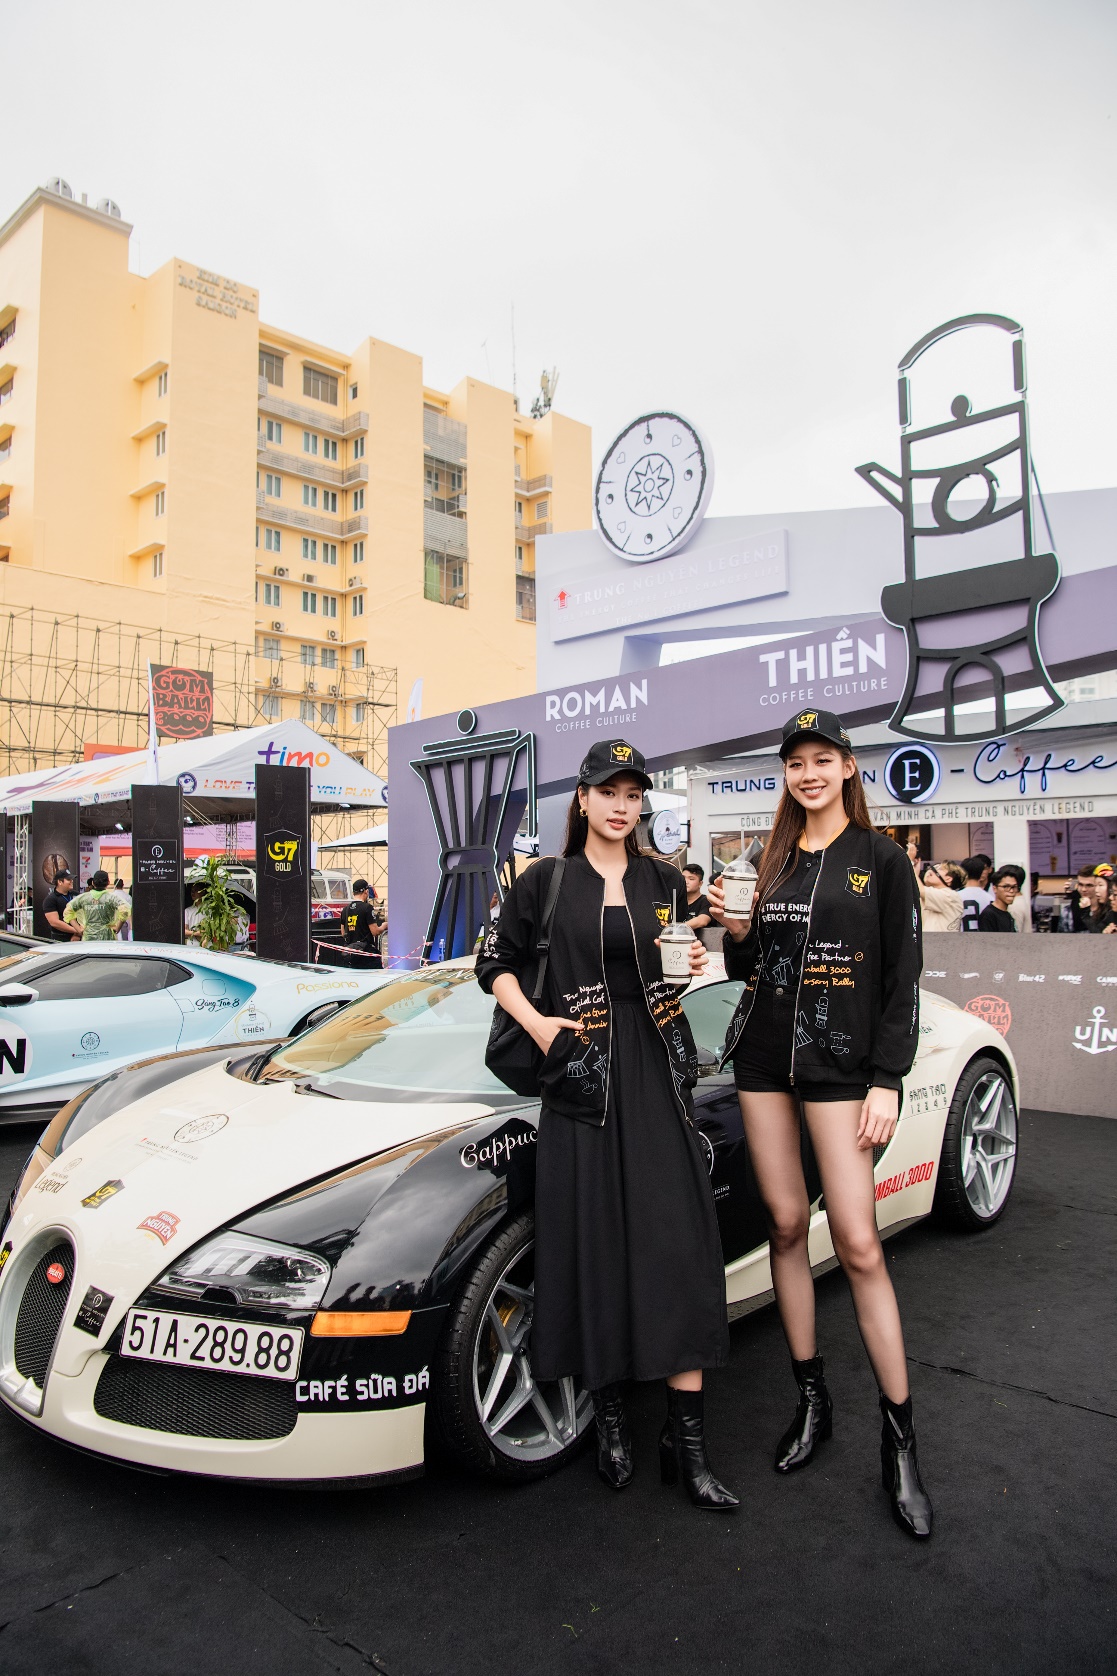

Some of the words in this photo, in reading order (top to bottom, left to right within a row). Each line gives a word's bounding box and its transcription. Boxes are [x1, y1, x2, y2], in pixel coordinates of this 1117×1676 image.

[178, 275, 217, 299] ROYAL
[220, 290, 256, 314] HOTEL
[196, 296, 237, 319] SAIGON
[574, 582, 625, 606] TRUNG
[707, 544, 780, 574] LEGEND
[546, 678, 649, 722] ROMAN
[760, 688, 815, 707] COFFEE
[824, 677, 889, 698] CULTURE
[556, 719, 593, 734] COFFEE
[596, 713, 638, 728] CULTURE
[258, 741, 330, 767] timo
[973, 741, 1117, 796] Coffee
[204, 779, 242, 790] LOVE
[317, 786, 342, 795] YOU
[344, 788, 376, 798] PLAY
[708, 776, 777, 799] TRUNG
[896, 808, 919, 821] MINH
[941, 805, 960, 819] PHÊ
[965, 804, 998, 818] TRUNG
[1052, 801, 1094, 814] LEGEND
[275, 862, 291, 871] GOLD
[766, 903, 785, 912] TRUE
[790, 914, 802, 922] OF
[822, 952, 852, 962] Partner
[830, 966, 852, 974] 3000
[297, 978, 361, 994] Passiona
[832, 978, 855, 988] Rally
[905, 1161, 934, 1188] 3000
[127, 1313, 294, 1372] 51A-289.88
[295, 1376, 349, 1402] CAFÉ
[402, 1365, 429, 1392] ĐÁ
